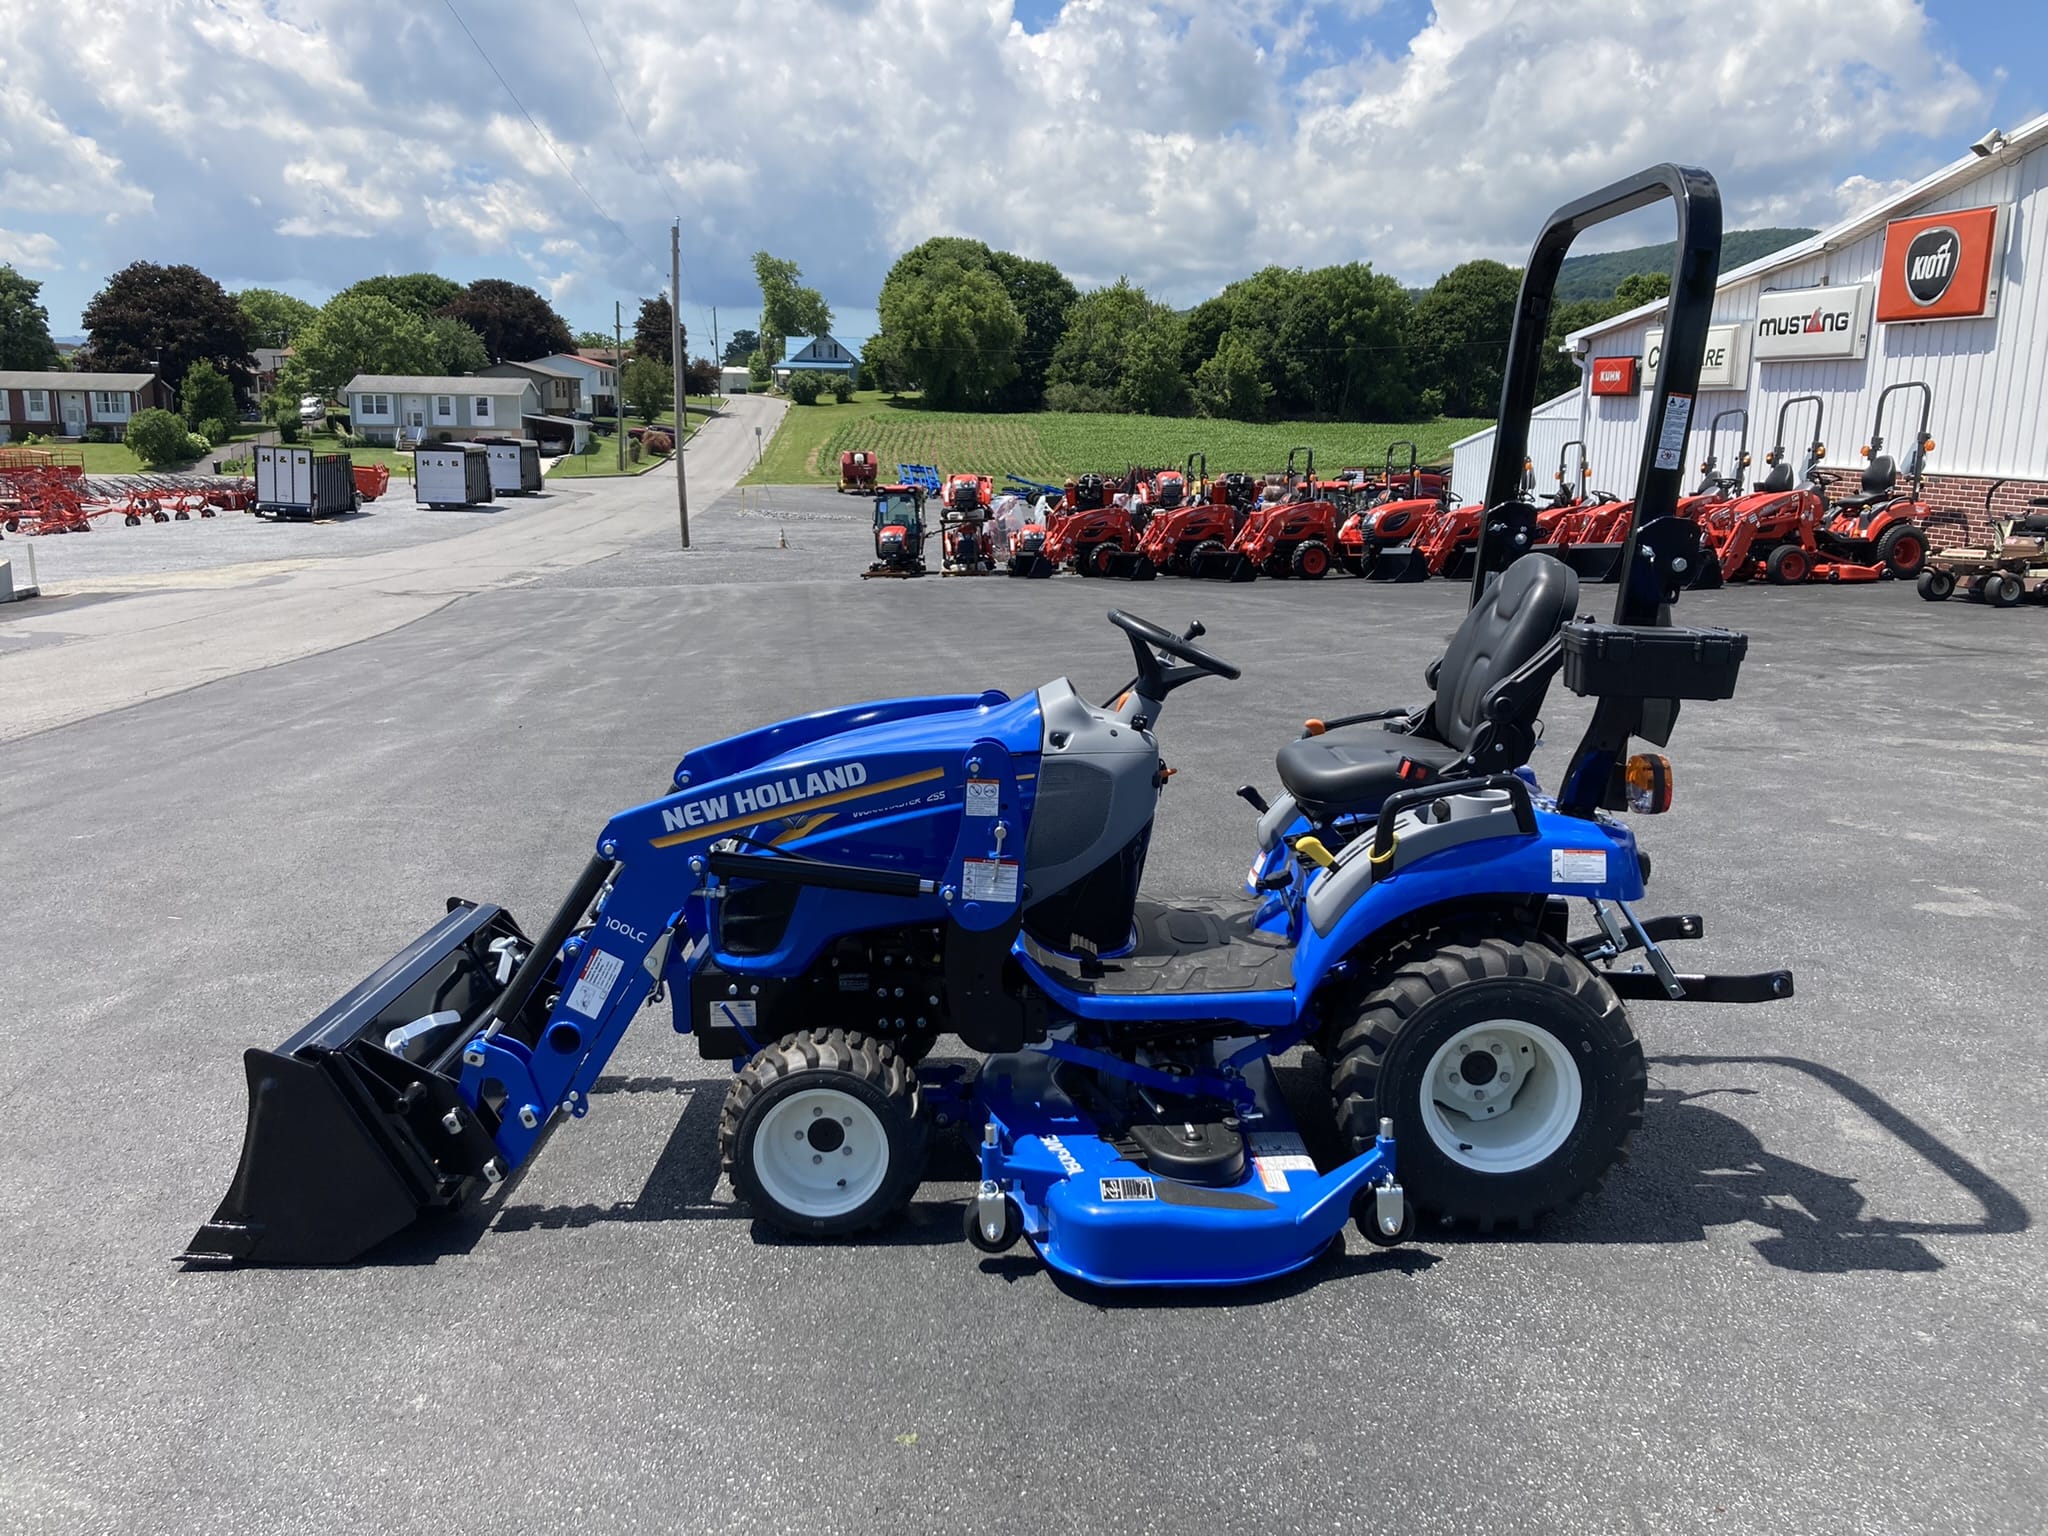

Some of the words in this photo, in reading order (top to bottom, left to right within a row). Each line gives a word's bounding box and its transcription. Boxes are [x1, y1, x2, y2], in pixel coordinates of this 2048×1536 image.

[1911, 252, 1952, 281] KIOTI
[1759, 309, 1850, 336] MUSTANG
[661, 794, 729, 833] NEW
[733, 762, 867, 814] HOLLAND
[605, 916, 648, 944] 100LC
